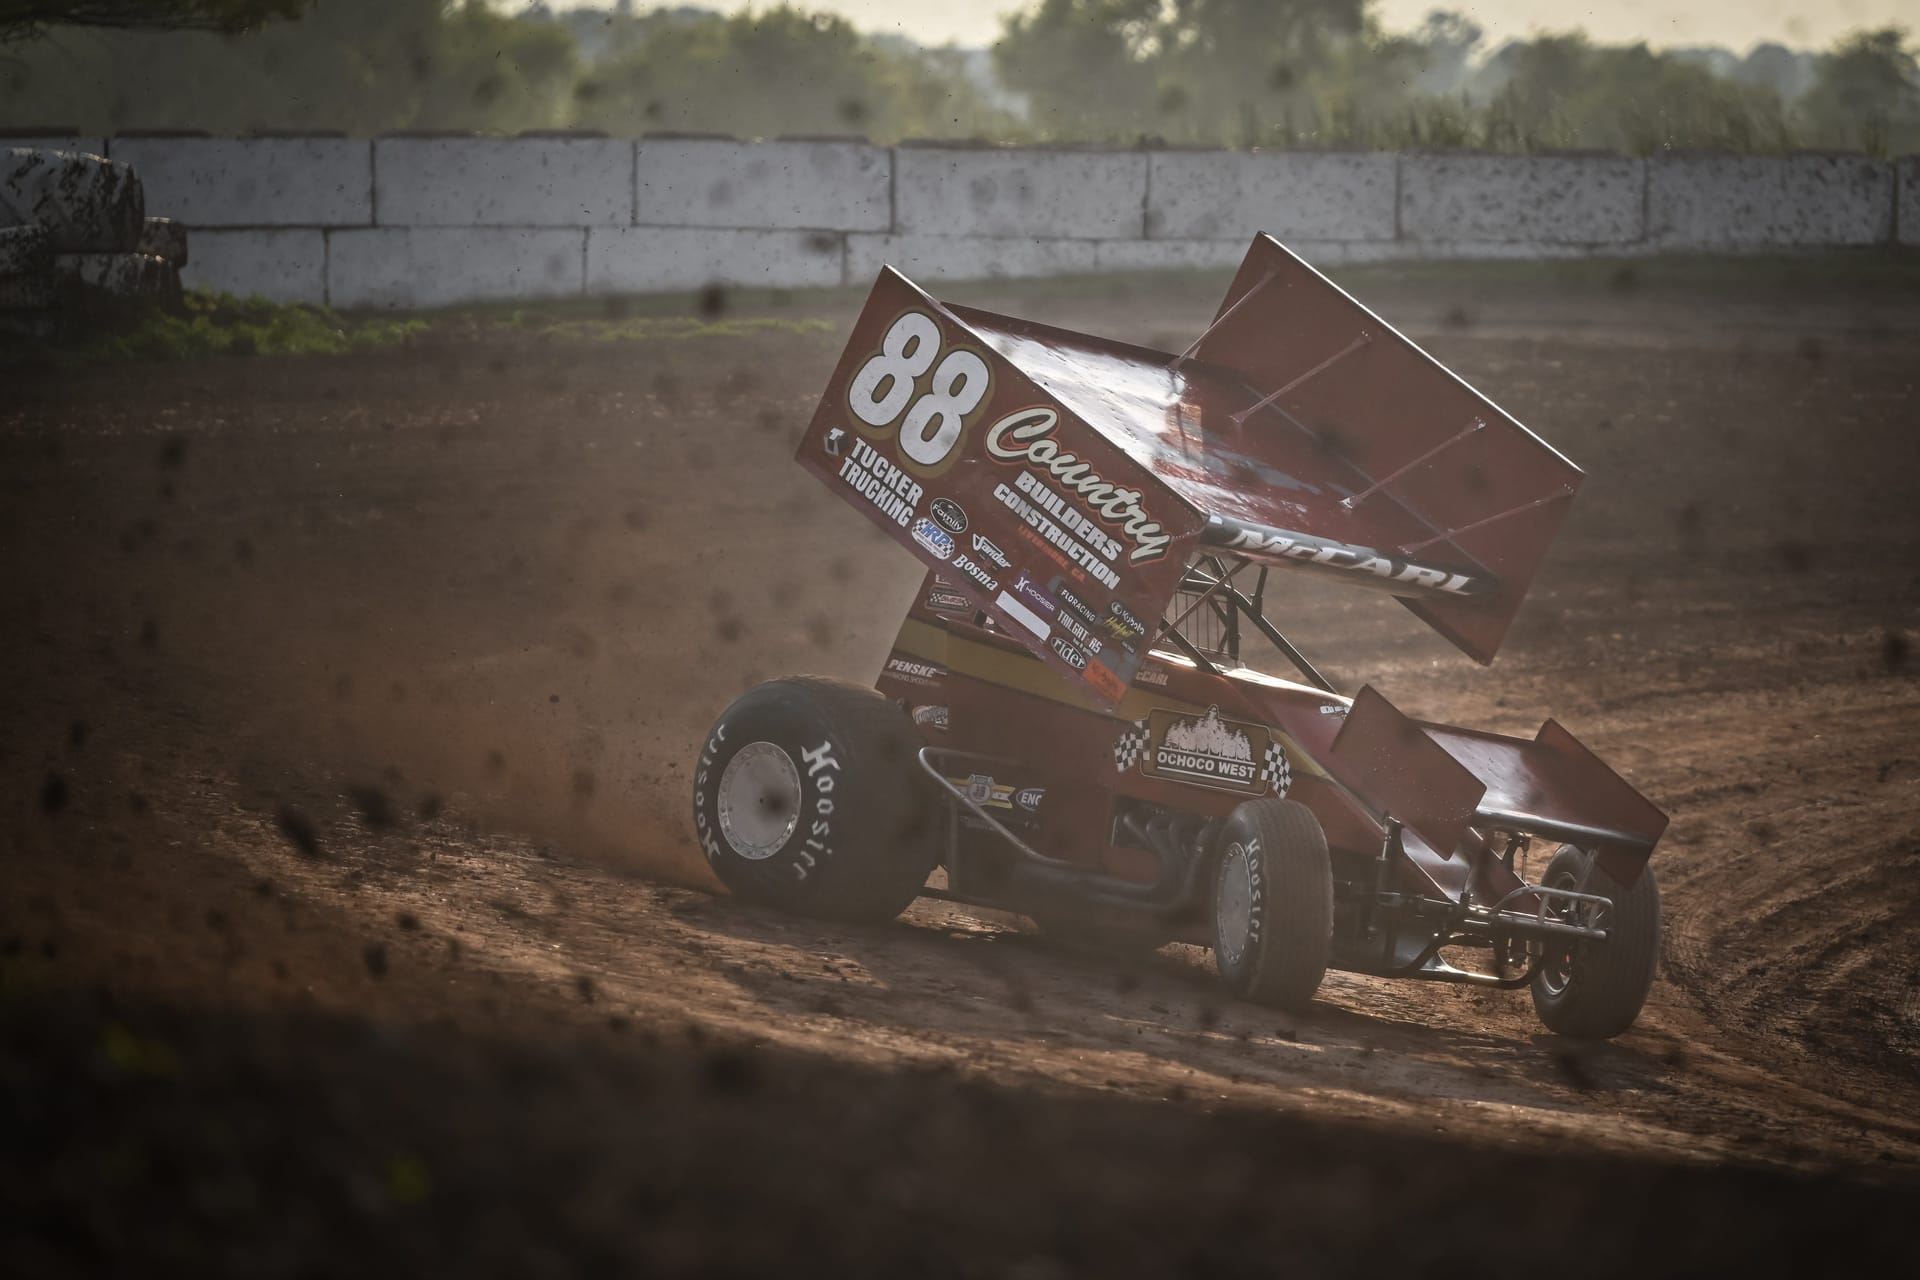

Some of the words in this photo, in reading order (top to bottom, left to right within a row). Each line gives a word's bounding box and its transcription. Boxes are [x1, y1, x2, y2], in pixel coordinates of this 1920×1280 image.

[848, 311, 990, 467] 88
[839, 457, 914, 528] TRUCKING
[851, 437, 924, 507] TUCKER
[986, 408, 1170, 560] Country
[920, 523, 951, 545] HRP
[932, 503, 963, 531] Family
[993, 483, 1121, 591] CONSTRUCTION
[1014, 470, 1123, 561] BUILDERS
[952, 554, 999, 591] Bosma
[1025, 586, 1056, 612] HOOSIER
[888, 659, 937, 678] PENSKE
[1054, 640, 1085, 667] rider
[1157, 751, 1215, 772] OCHOCO
[1218, 760, 1257, 779] WEST
[793, 740, 841, 880] Hoosier
